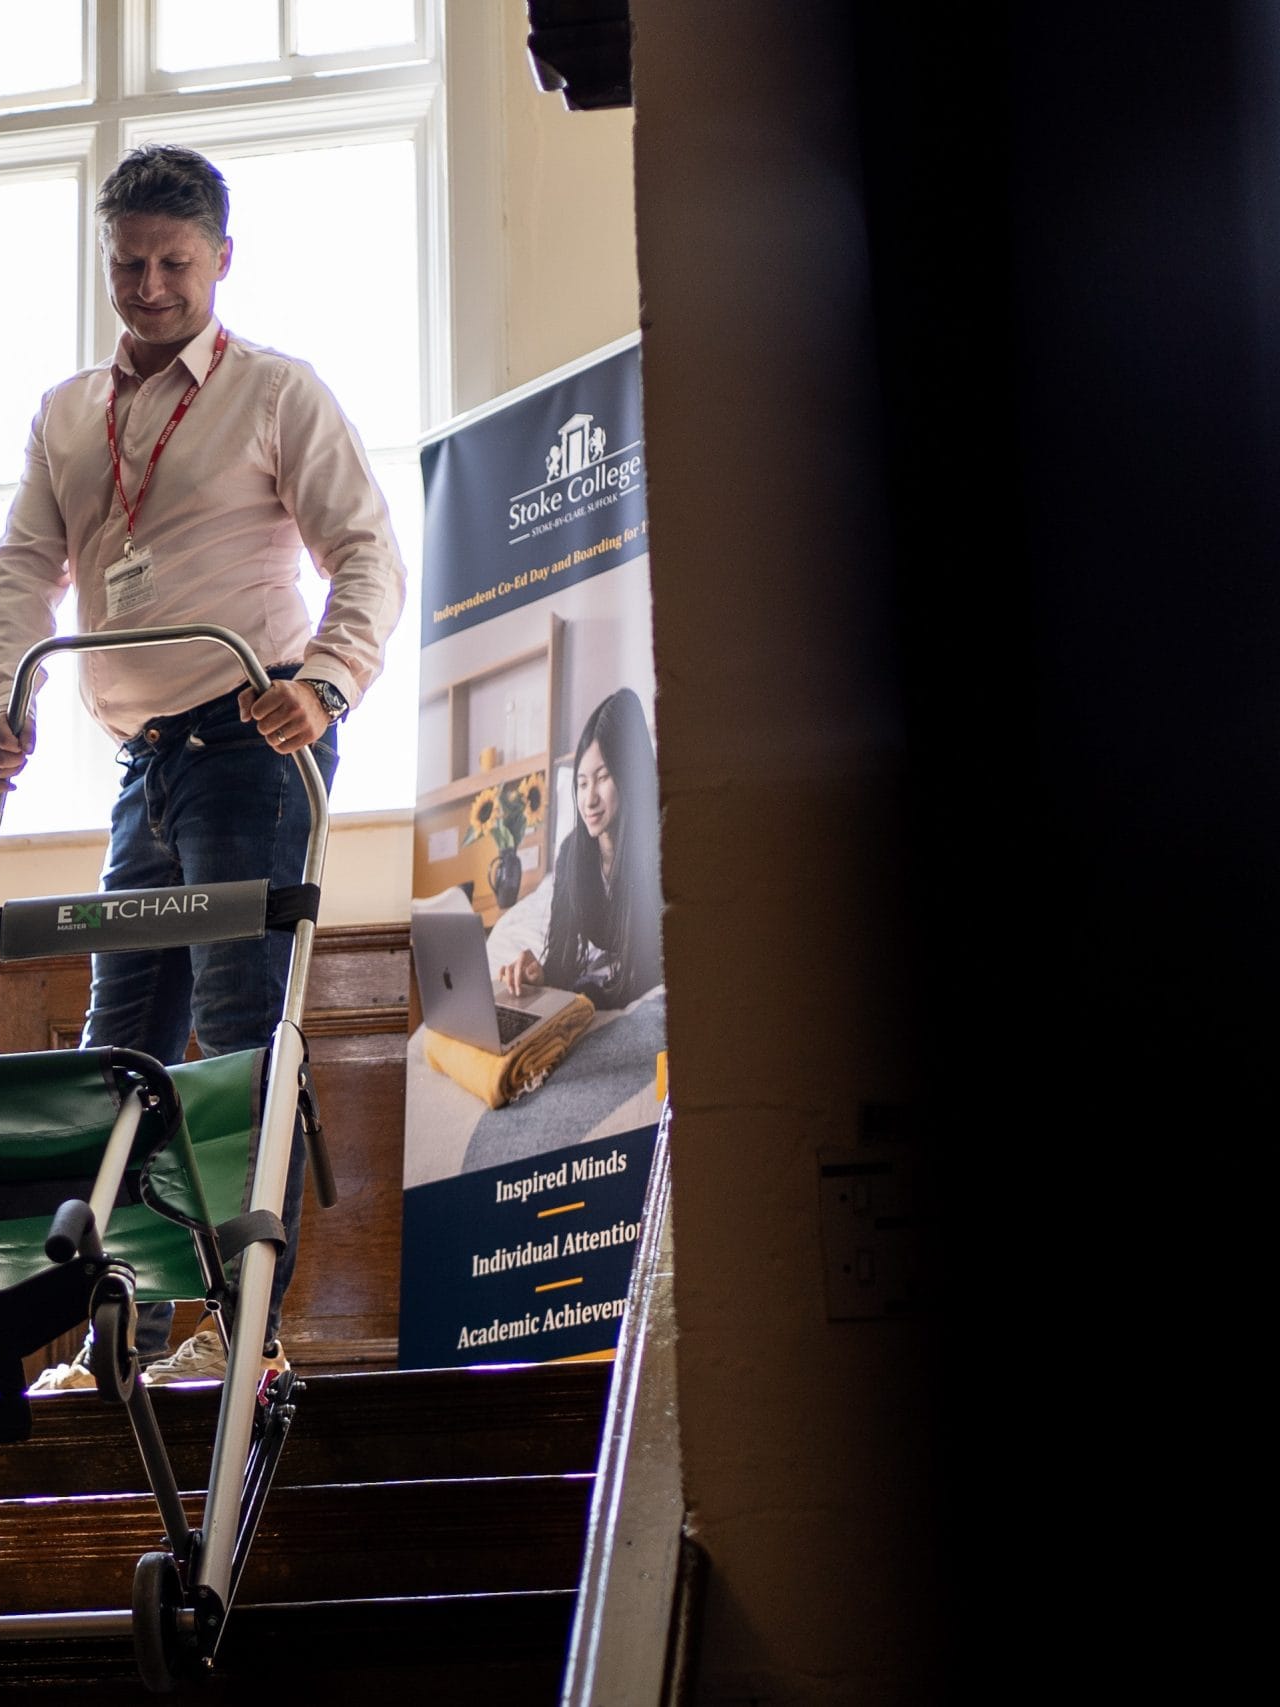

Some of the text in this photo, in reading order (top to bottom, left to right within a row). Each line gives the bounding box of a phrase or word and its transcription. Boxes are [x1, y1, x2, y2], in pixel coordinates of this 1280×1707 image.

[509, 456, 641, 530] Stoke College
[587, 493, 619, 514] SUFFOLK
[433, 587, 496, 623] Independent
[497, 573, 528, 596] Co-Ed
[529, 565, 550, 583] Day
[551, 554, 572, 575] and
[573, 534, 622, 564] Boarding
[623, 527, 639, 543] for
[495, 1150, 627, 1203] Inspired Minds
[472, 1235, 559, 1277] Individual
[457, 1313, 540, 1350] Academic
